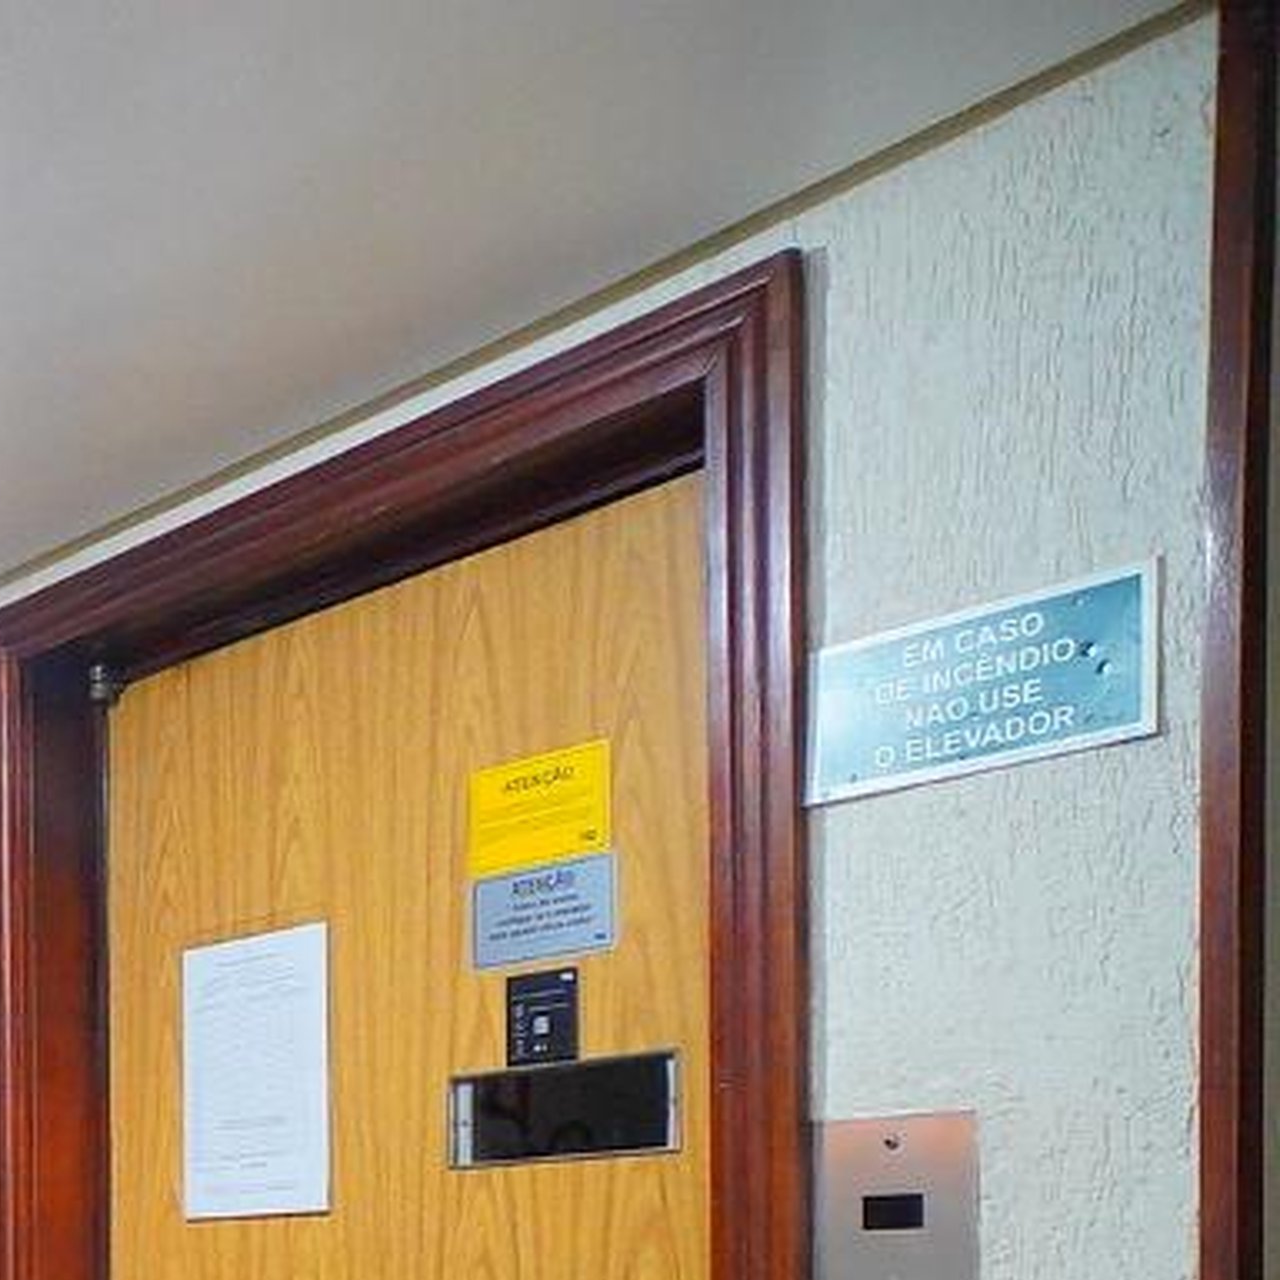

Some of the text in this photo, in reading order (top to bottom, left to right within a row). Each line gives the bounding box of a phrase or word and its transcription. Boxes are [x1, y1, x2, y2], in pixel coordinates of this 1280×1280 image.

[904, 612, 1044, 668] EM CASO
[924, 638, 1076, 693] INCÊNDIO
[979, 679, 1042, 713] USE
[875, 707, 1074, 768] O ELEVADOR
